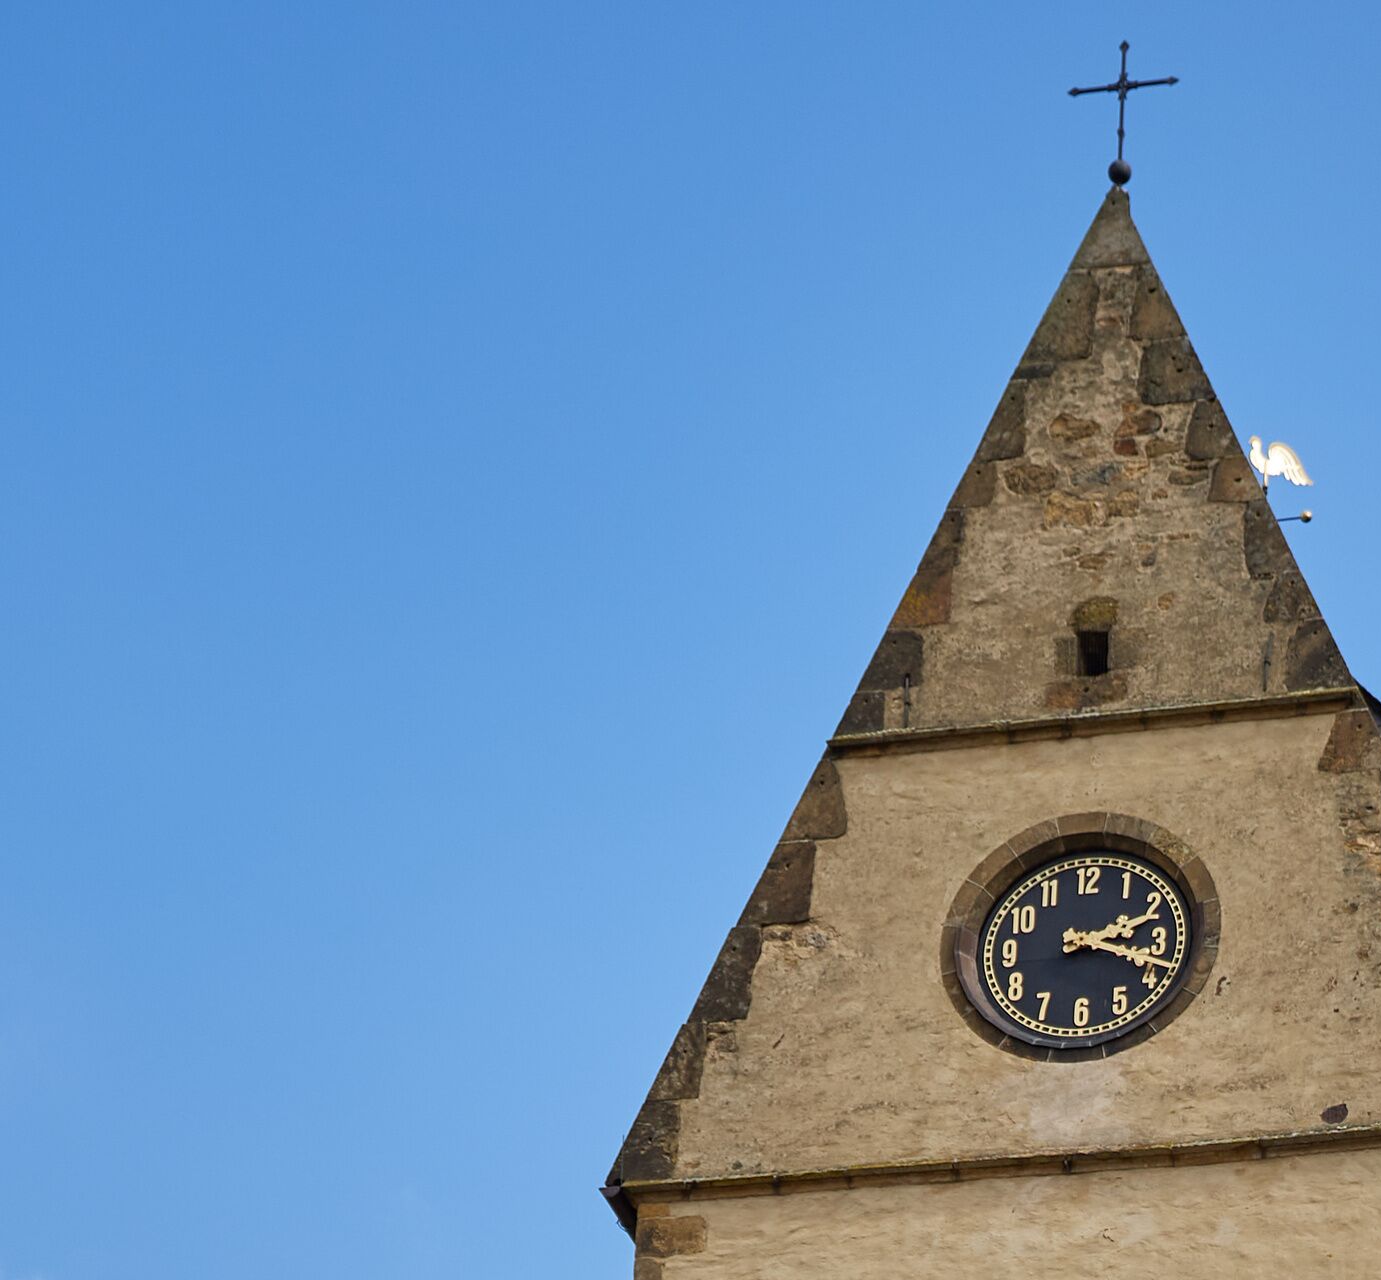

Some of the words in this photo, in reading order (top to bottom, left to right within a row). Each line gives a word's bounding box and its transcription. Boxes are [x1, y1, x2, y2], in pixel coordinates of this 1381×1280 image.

[1040, 879, 1058, 907] 11
[1076, 866, 1101, 895] 12
[1121, 871, 1132, 899] 1
[1146, 891, 1162, 918] 2
[1011, 905, 1036, 934] 10
[1002, 939, 1017, 968] 9
[1151, 927, 1166, 956] 3
[1008, 972, 1024, 1001] 8
[1142, 962, 1157, 989] 4
[1036, 991, 1050, 1021] 7
[1073, 997, 1089, 1027] 6
[1112, 986, 1128, 1016] 5
